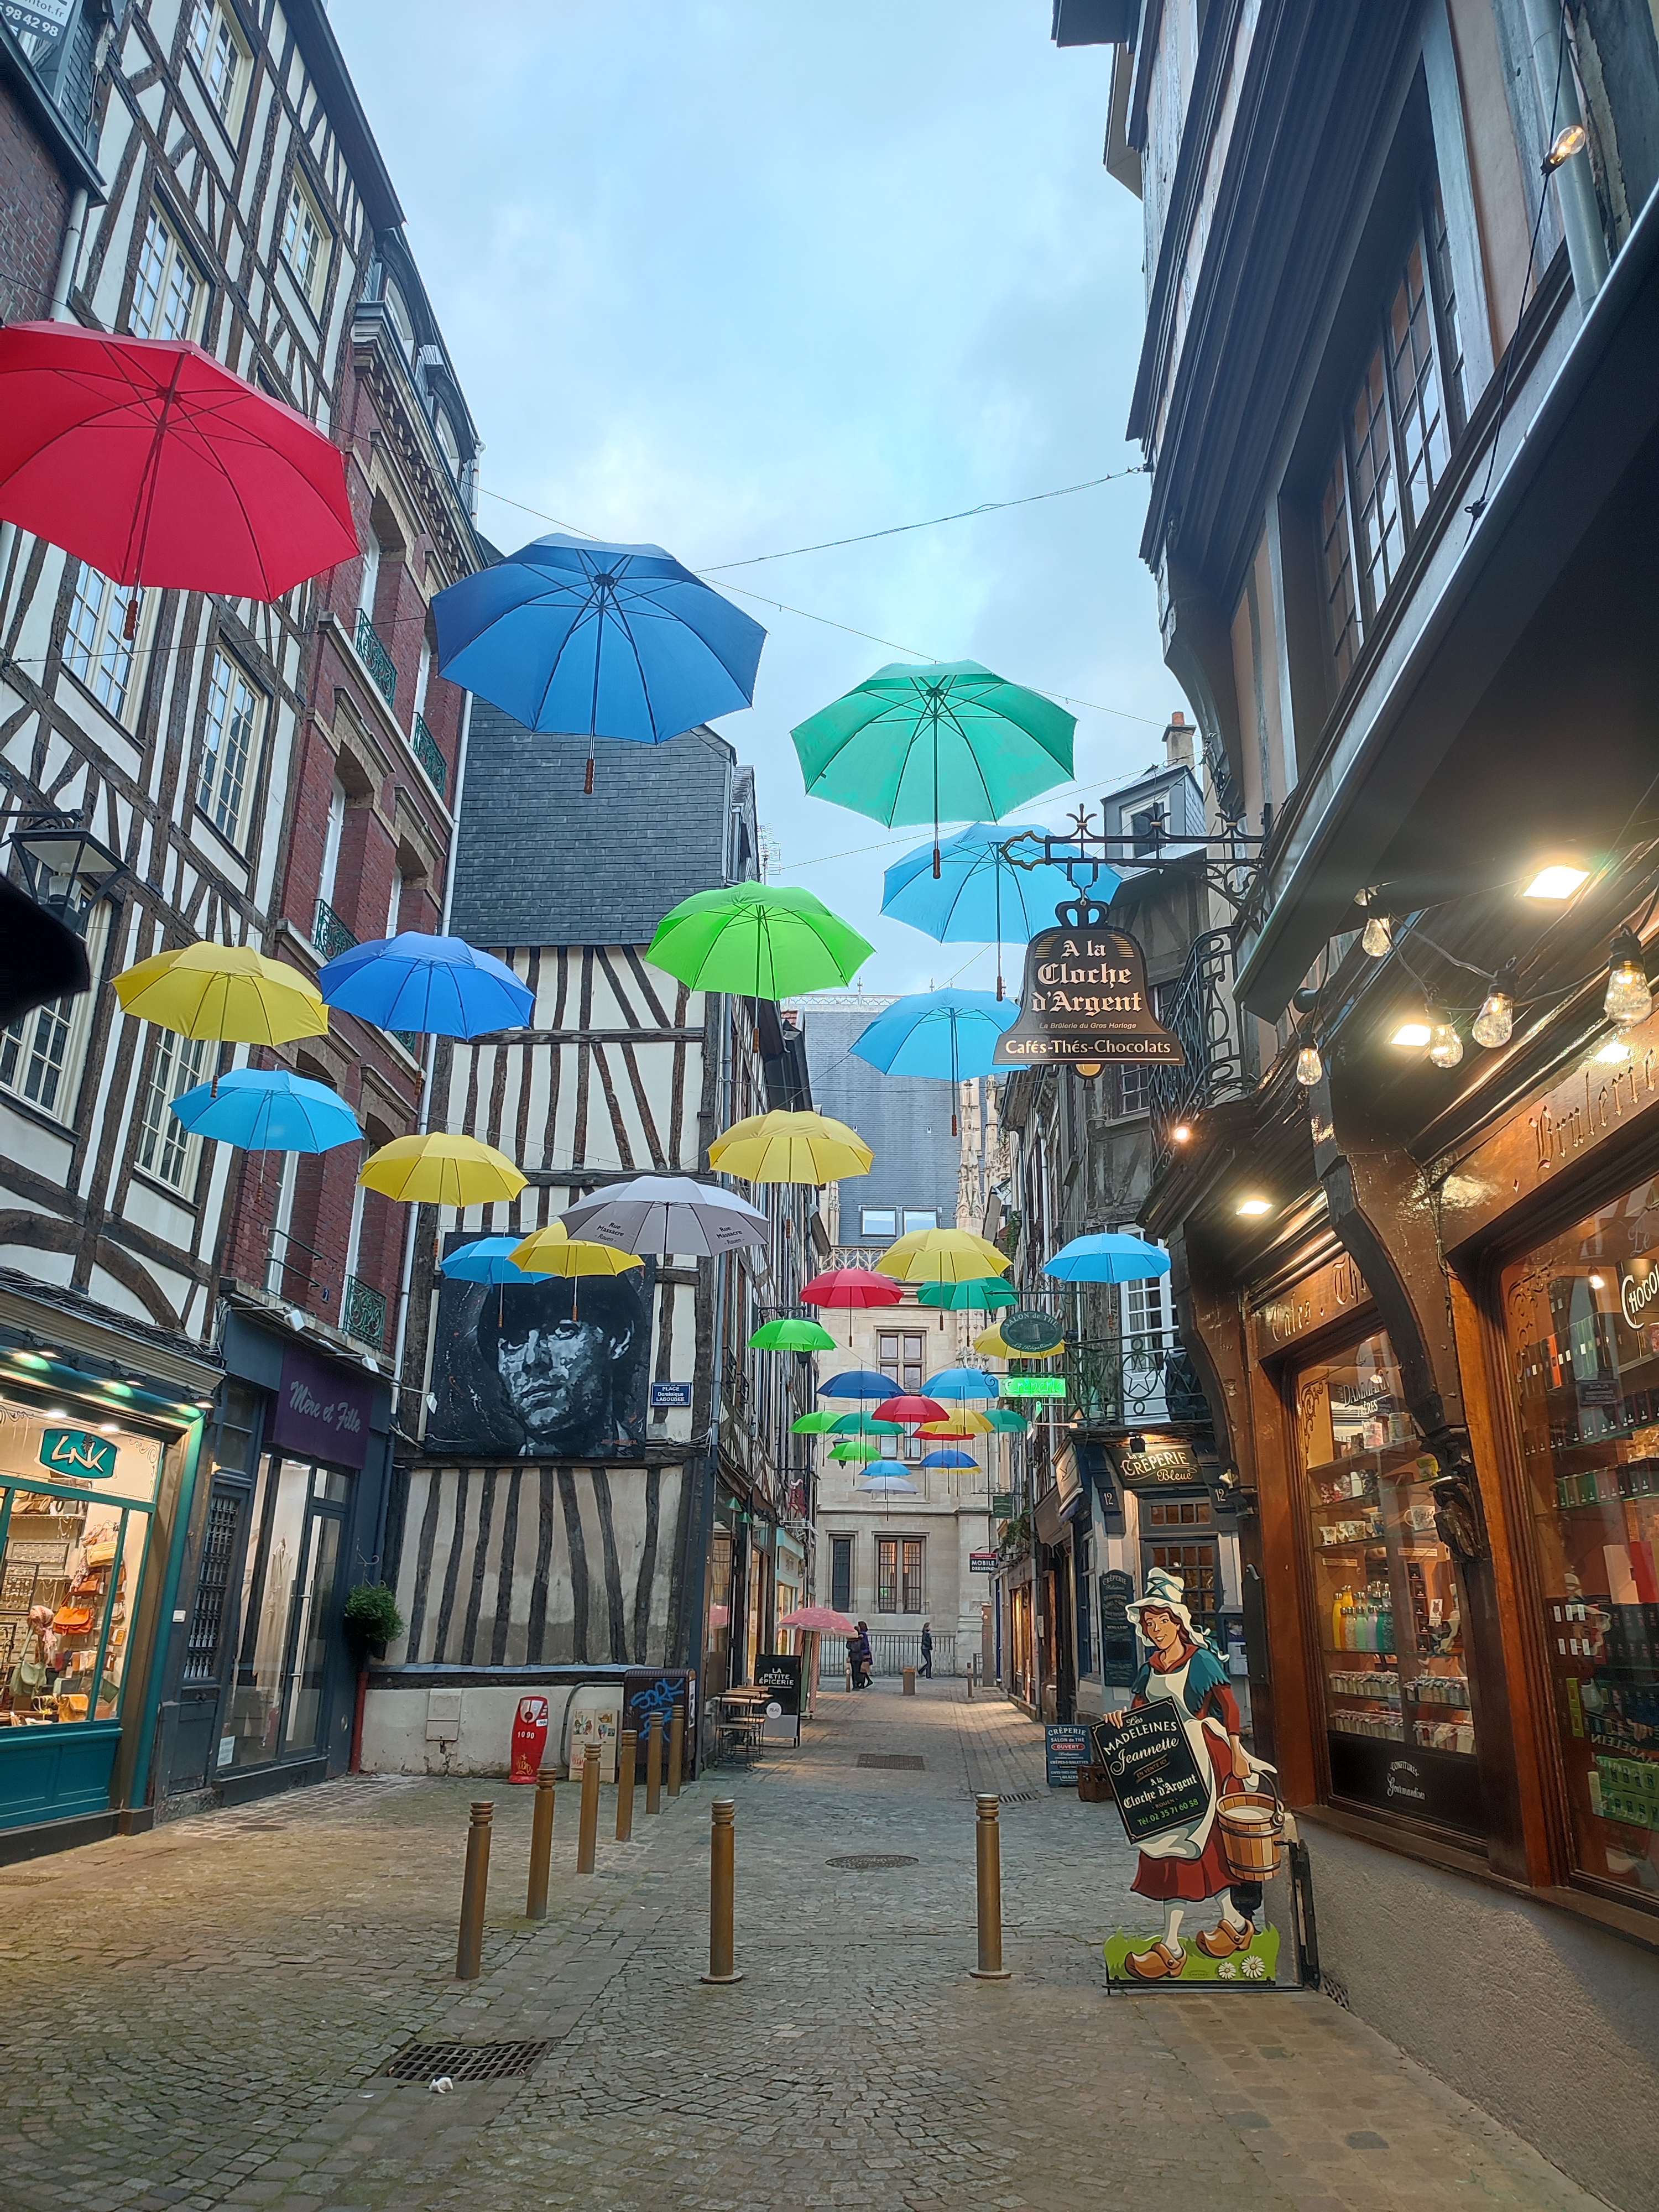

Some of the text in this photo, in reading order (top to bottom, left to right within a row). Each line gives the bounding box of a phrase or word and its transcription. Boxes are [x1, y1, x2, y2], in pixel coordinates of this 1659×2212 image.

[6, 6, 22, 20] 98
[23, 14, 40, 29] 42
[42, 22, 59, 36] 98
[1061, 940, 1107, 958] A la
[1037, 963, 1133, 989] Cloche
[1031, 990, 1142, 1016] d'Argent
[1005, 1040, 1171, 1054] Cafés-Thés-Chocolats
[597, 1225, 624, 1237] Massacre
[716, 1230, 743, 1239] Massacre
[1004, 1312, 1030, 1328] SALON
[290, 1381, 361, 1433] Mère et Fille
[1104, 1493, 1114, 1505] 12
[1215, 1489, 1226, 1502] 12
[759, 1677, 794, 1685] ÉPICERIE
[1126, 1715, 1143, 1728] Les
[1048, 1726, 1087, 1736] CRÊPERIE
[1103, 1721, 1177, 1756] MADELEINES
[1110, 1738, 1180, 1776] Jeannette
[1144, 1763, 1160, 1774] VENTE
[1150, 1778, 1157, 1786] A
[1123, 1773, 1198, 1809] Cloche d'Argent
[1160, 1809, 1170, 1818] 35
[1179, 1802, 1189, 1811] 60
[1188, 1798, 1199, 1808] 58
